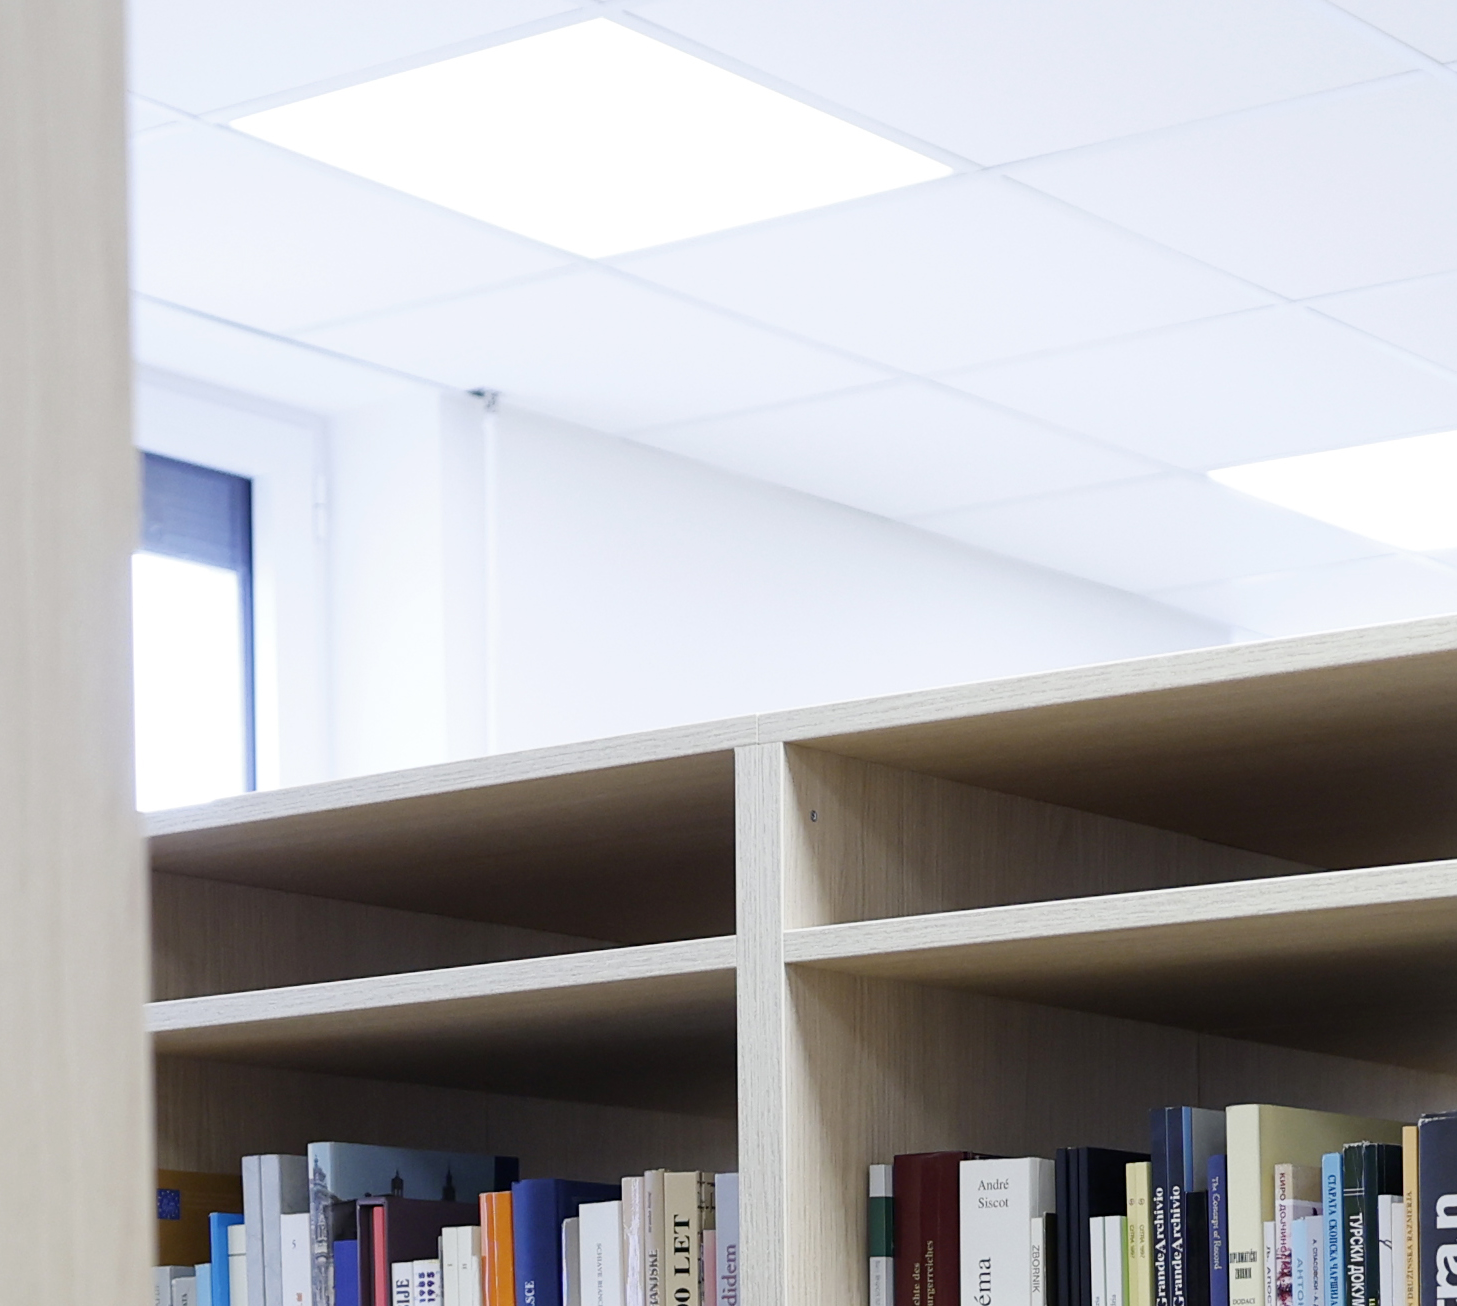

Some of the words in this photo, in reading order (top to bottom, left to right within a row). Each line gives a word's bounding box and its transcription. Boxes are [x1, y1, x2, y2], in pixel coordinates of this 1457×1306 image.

[978, 1180, 1009, 1191] André
[977, 1199, 1009, 1208] Siscot
[673, 1214, 691, 1276] LET
[912, 1263, 920, 1281] des
[1032, 1245, 1040, 1292] ZBORNIK
[427, 1271, 435, 1303] 1995
